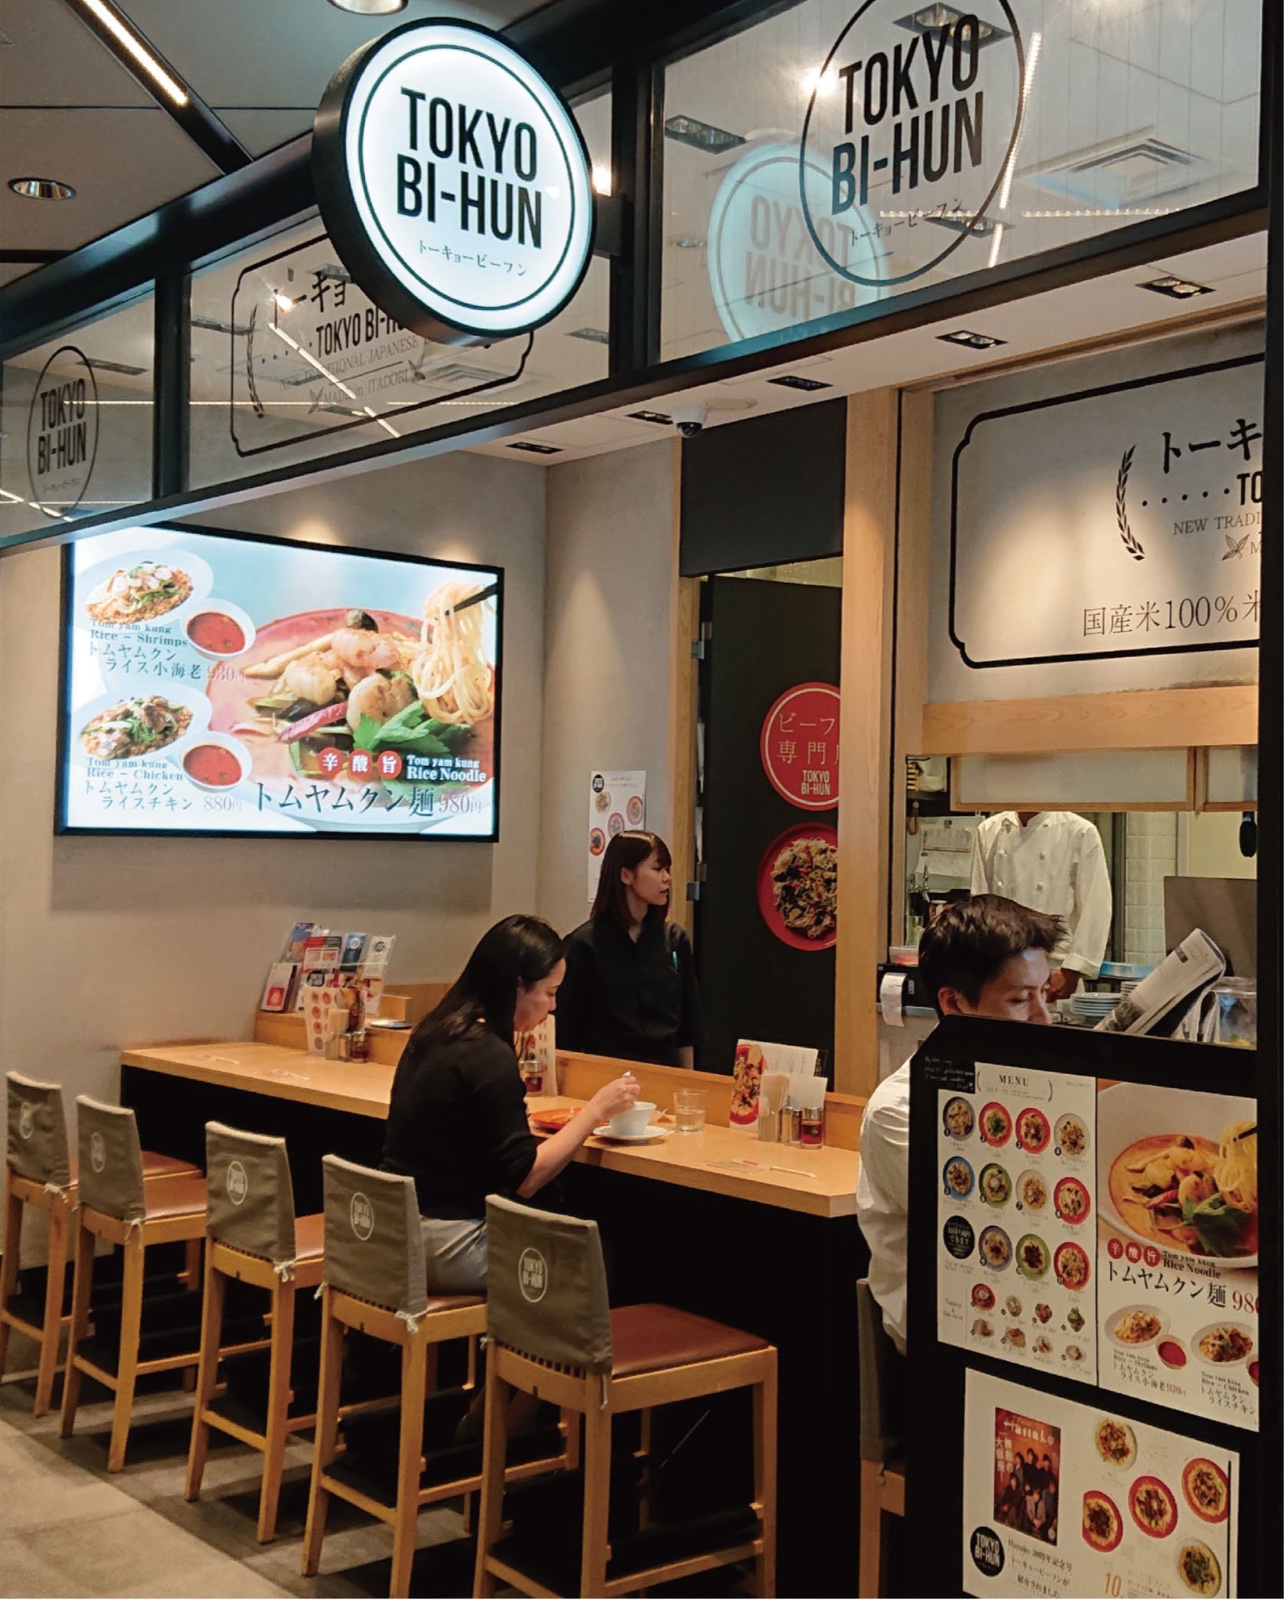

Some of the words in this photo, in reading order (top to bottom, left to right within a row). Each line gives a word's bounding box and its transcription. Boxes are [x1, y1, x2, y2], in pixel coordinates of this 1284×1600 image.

[839, 14, 979, 135] TOKYO
[400, 86, 537, 182] TOKYO
[831, 91, 984, 215] BI-HUN
[397, 153, 542, 250] BI-HUN
[419, 239, 527, 277] トーキョービーフン
[316, 313, 361, 358] TOKYO
[40, 378, 86, 431] TOKYO
[37, 421, 87, 475] BI-HUN
[1172, 518, 1208, 535] NEW
[118, 621, 141, 632] yam
[144, 621, 172, 634] kung
[91, 630, 119, 640] Rice
[137, 633, 188, 648] Shrimps
[90, 641, 177, 661] トムヤムクン
[105, 657, 202, 680] ライス小海老
[87, 757, 111, 767] Tom
[114, 759, 138, 769] yam
[141, 760, 168, 769] kung
[406, 754, 429, 766] Tom
[432, 757, 453, 769] yam
[455, 757, 480, 769] kung
[86, 767, 115, 778] Rice
[133, 768, 184, 781] Chicken
[406, 766, 437, 781] Rice
[439, 768, 487, 783] Noodle
[802, 769, 830, 784] TOKYO
[85, 780, 174, 796] トムヤムクン
[801, 781, 831, 796] BI-HUN
[102, 795, 193, 811] ライスチキン
[998, 1073, 1029, 1087] MENU
[523, 1257, 543, 1275] TOKYO
[1163, 1258, 1185, 1272] Rice
[1186, 1263, 1222, 1280] Noodle
[522, 1270, 543, 1289] BI-HUN
[1232, 1289, 1259, 1314] 98
[976, 1532, 1000, 1554] TOKYO
[974, 1545, 1001, 1568] BI-HUN
[1105, 1572, 1122, 1598] 10
